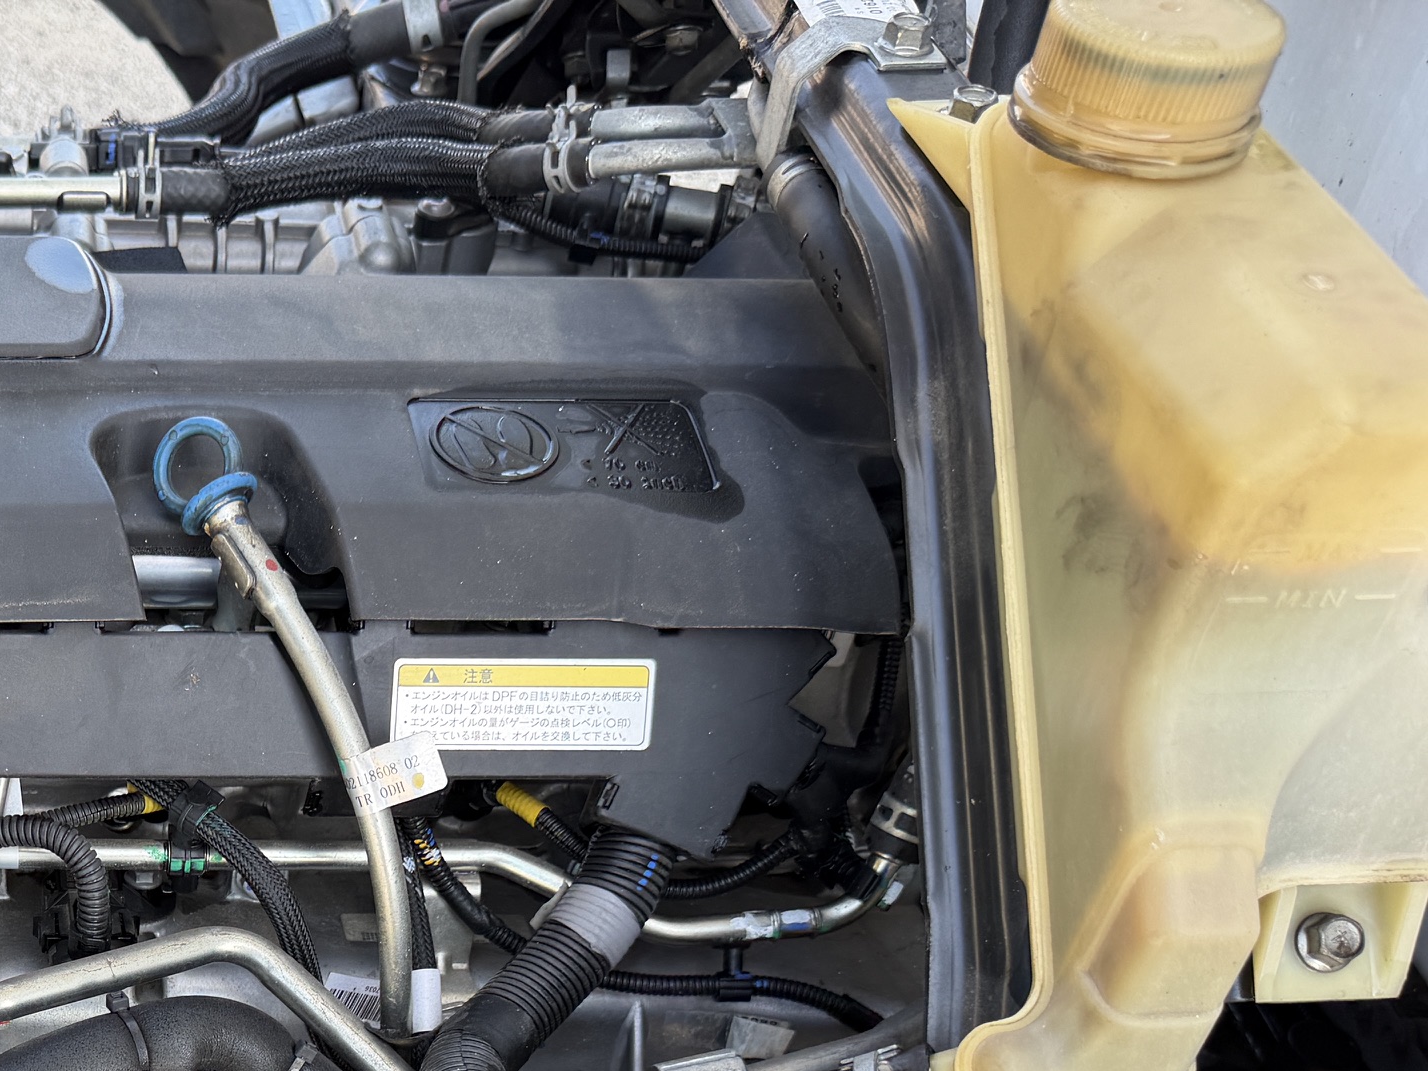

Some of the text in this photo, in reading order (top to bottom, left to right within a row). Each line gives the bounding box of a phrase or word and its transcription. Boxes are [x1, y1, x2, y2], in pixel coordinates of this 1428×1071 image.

[1274, 588, 1348, 609] MIN
[463, 669, 493, 684] 注意
[404, 755, 420, 769] 02
[356, 793, 373, 807] TR
